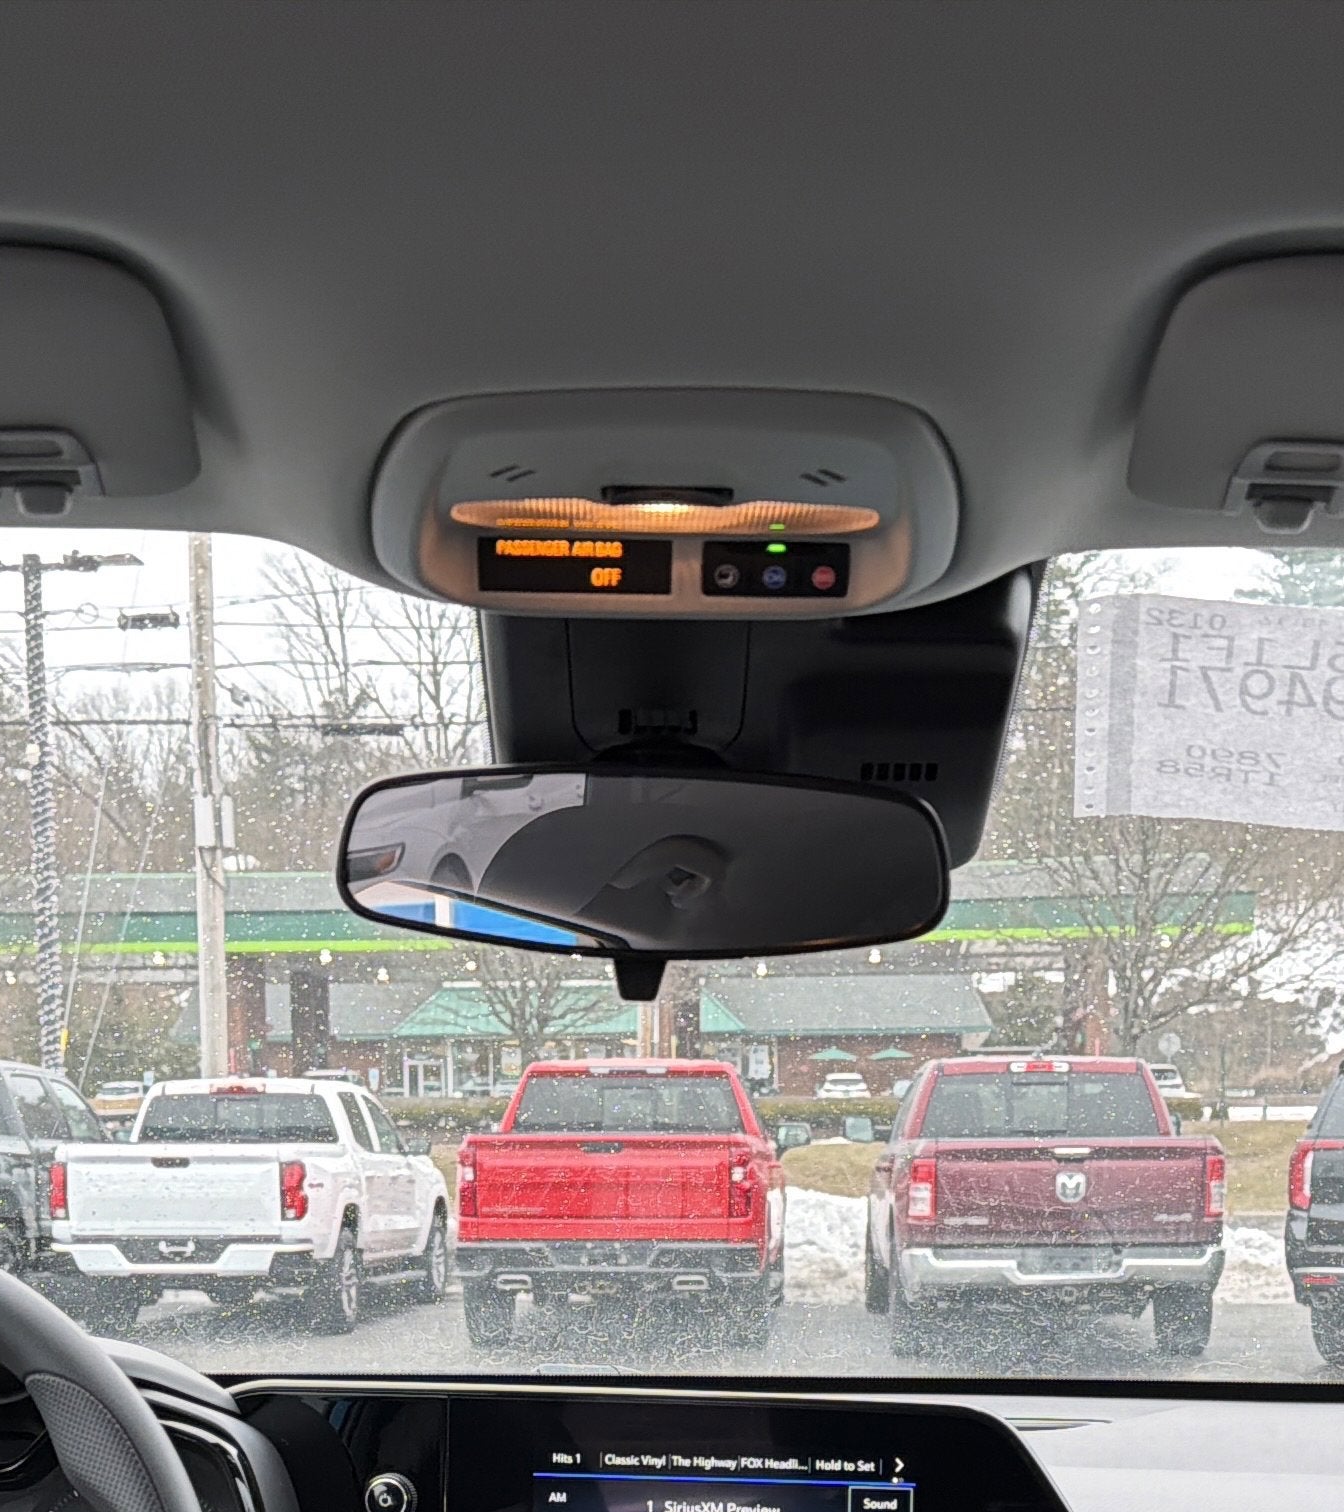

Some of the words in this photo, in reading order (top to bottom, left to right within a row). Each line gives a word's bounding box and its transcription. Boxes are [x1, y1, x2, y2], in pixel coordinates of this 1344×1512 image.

[591, 567, 622, 587] OFF
[552, 1453, 574, 1464] Hits
[604, 1454, 640, 1466] Classic
[641, 1455, 666, 1469] Vinyl
[671, 1455, 691, 1468] The
[692, 1456, 738, 1471] Highway
[740, 1457, 763, 1469] FOX
[815, 1459, 842, 1471] Hold
[843, 1461, 856, 1472] to
[857, 1460, 876, 1473] Set
[548, 1492, 567, 1504] AM
[862, 1497, 898, 1511] Sound
